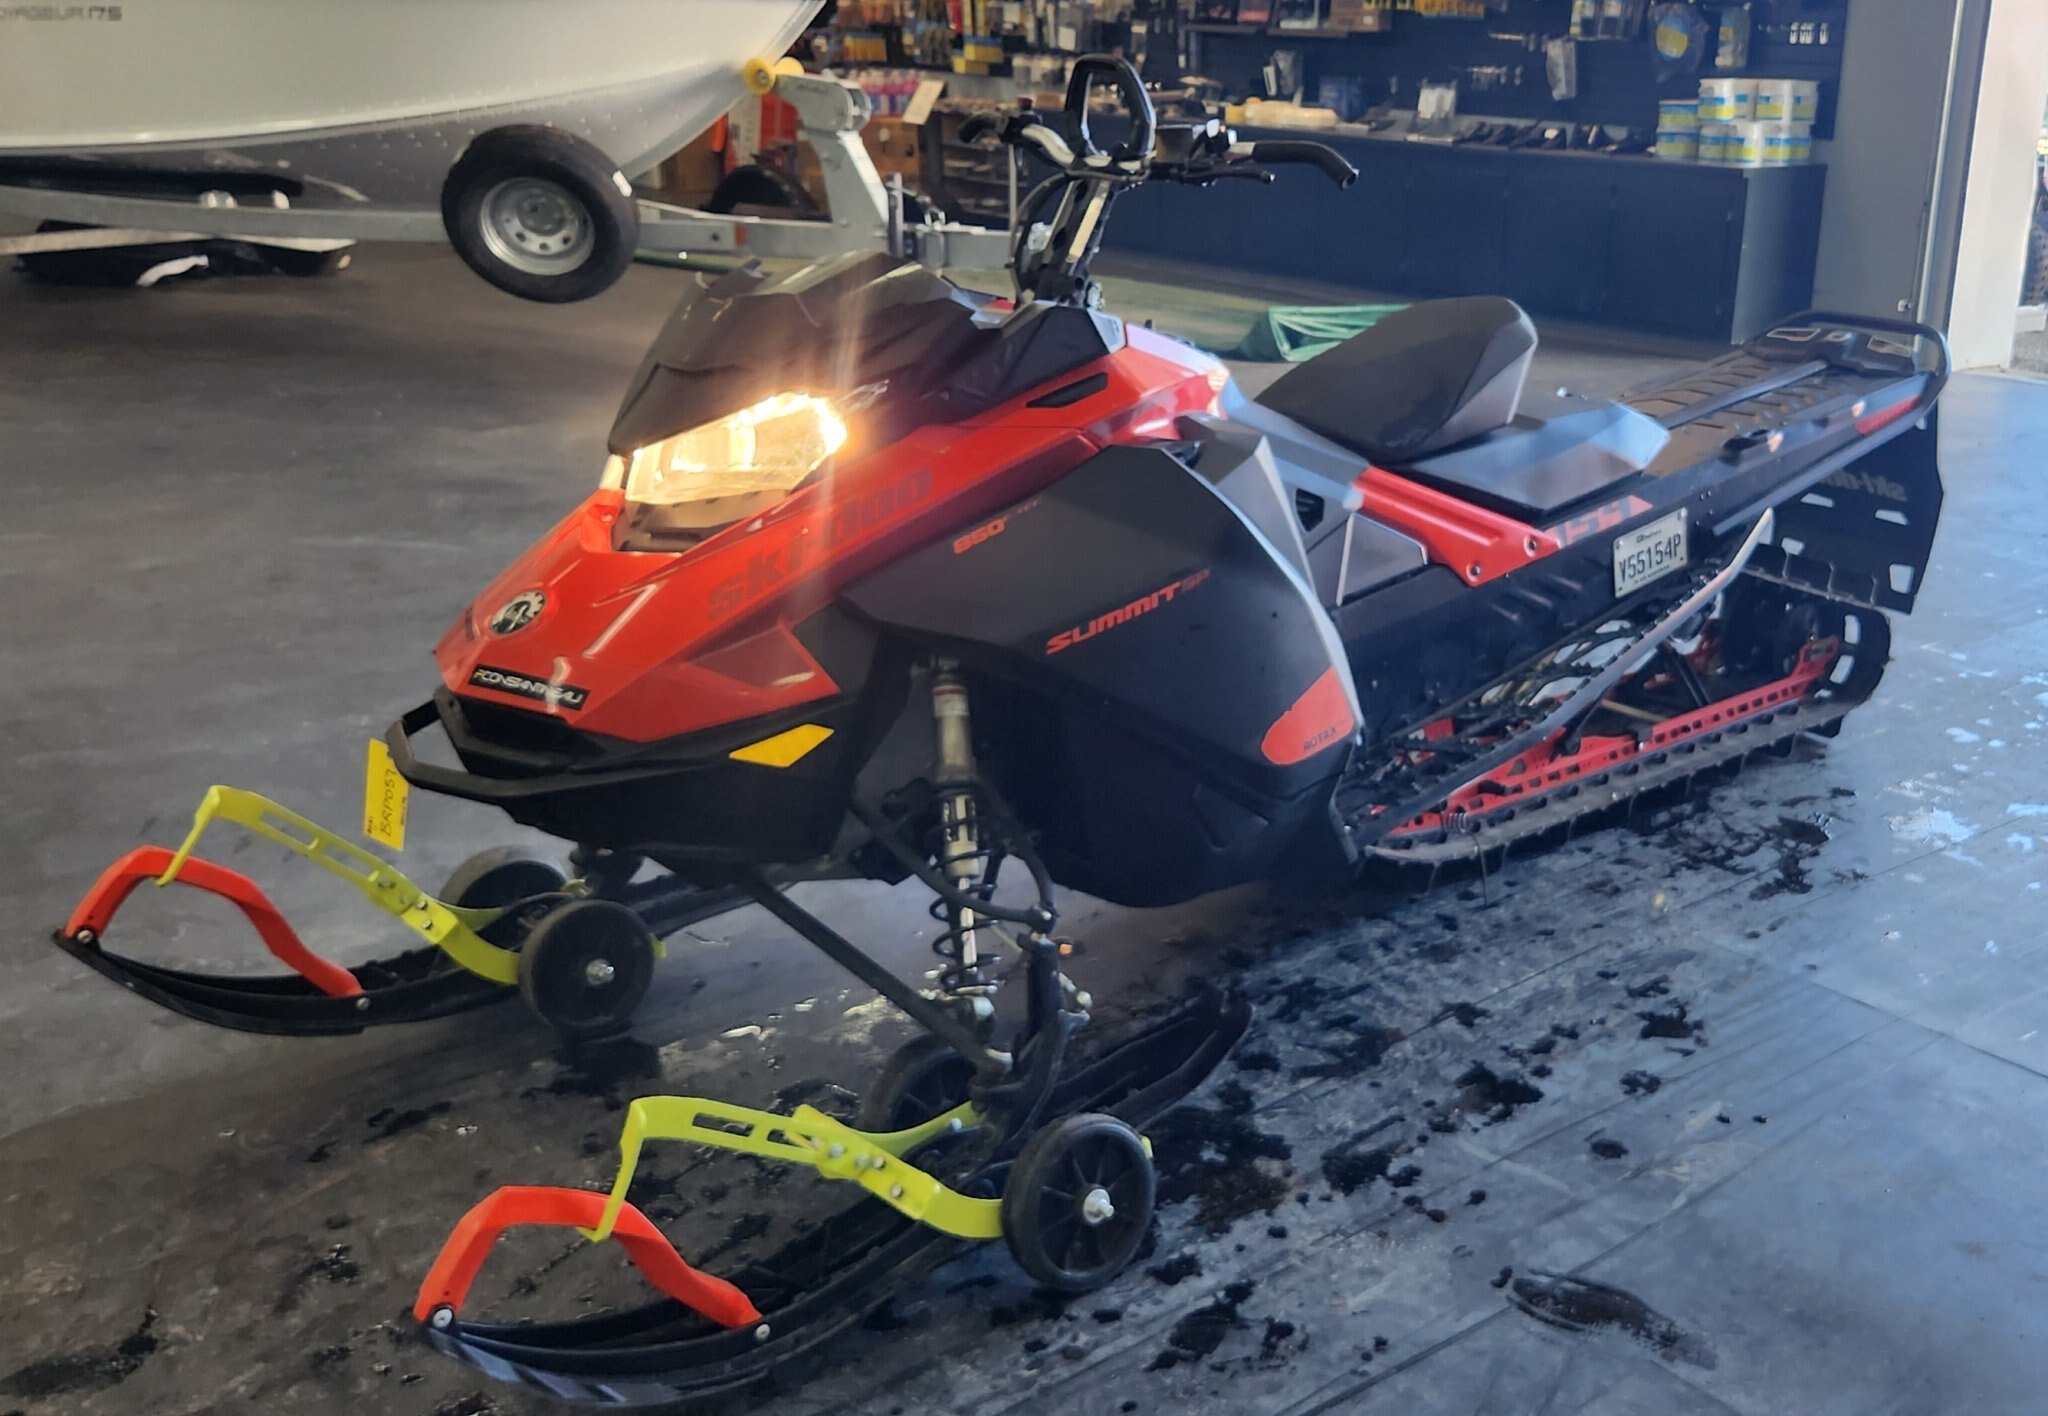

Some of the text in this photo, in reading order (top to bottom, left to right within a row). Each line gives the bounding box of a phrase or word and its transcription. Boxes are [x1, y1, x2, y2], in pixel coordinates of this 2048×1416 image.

[953, 518, 1006, 555] 850
[1619, 532, 1681, 583] V55154P
[1303, 726, 1338, 753] ROTAX
